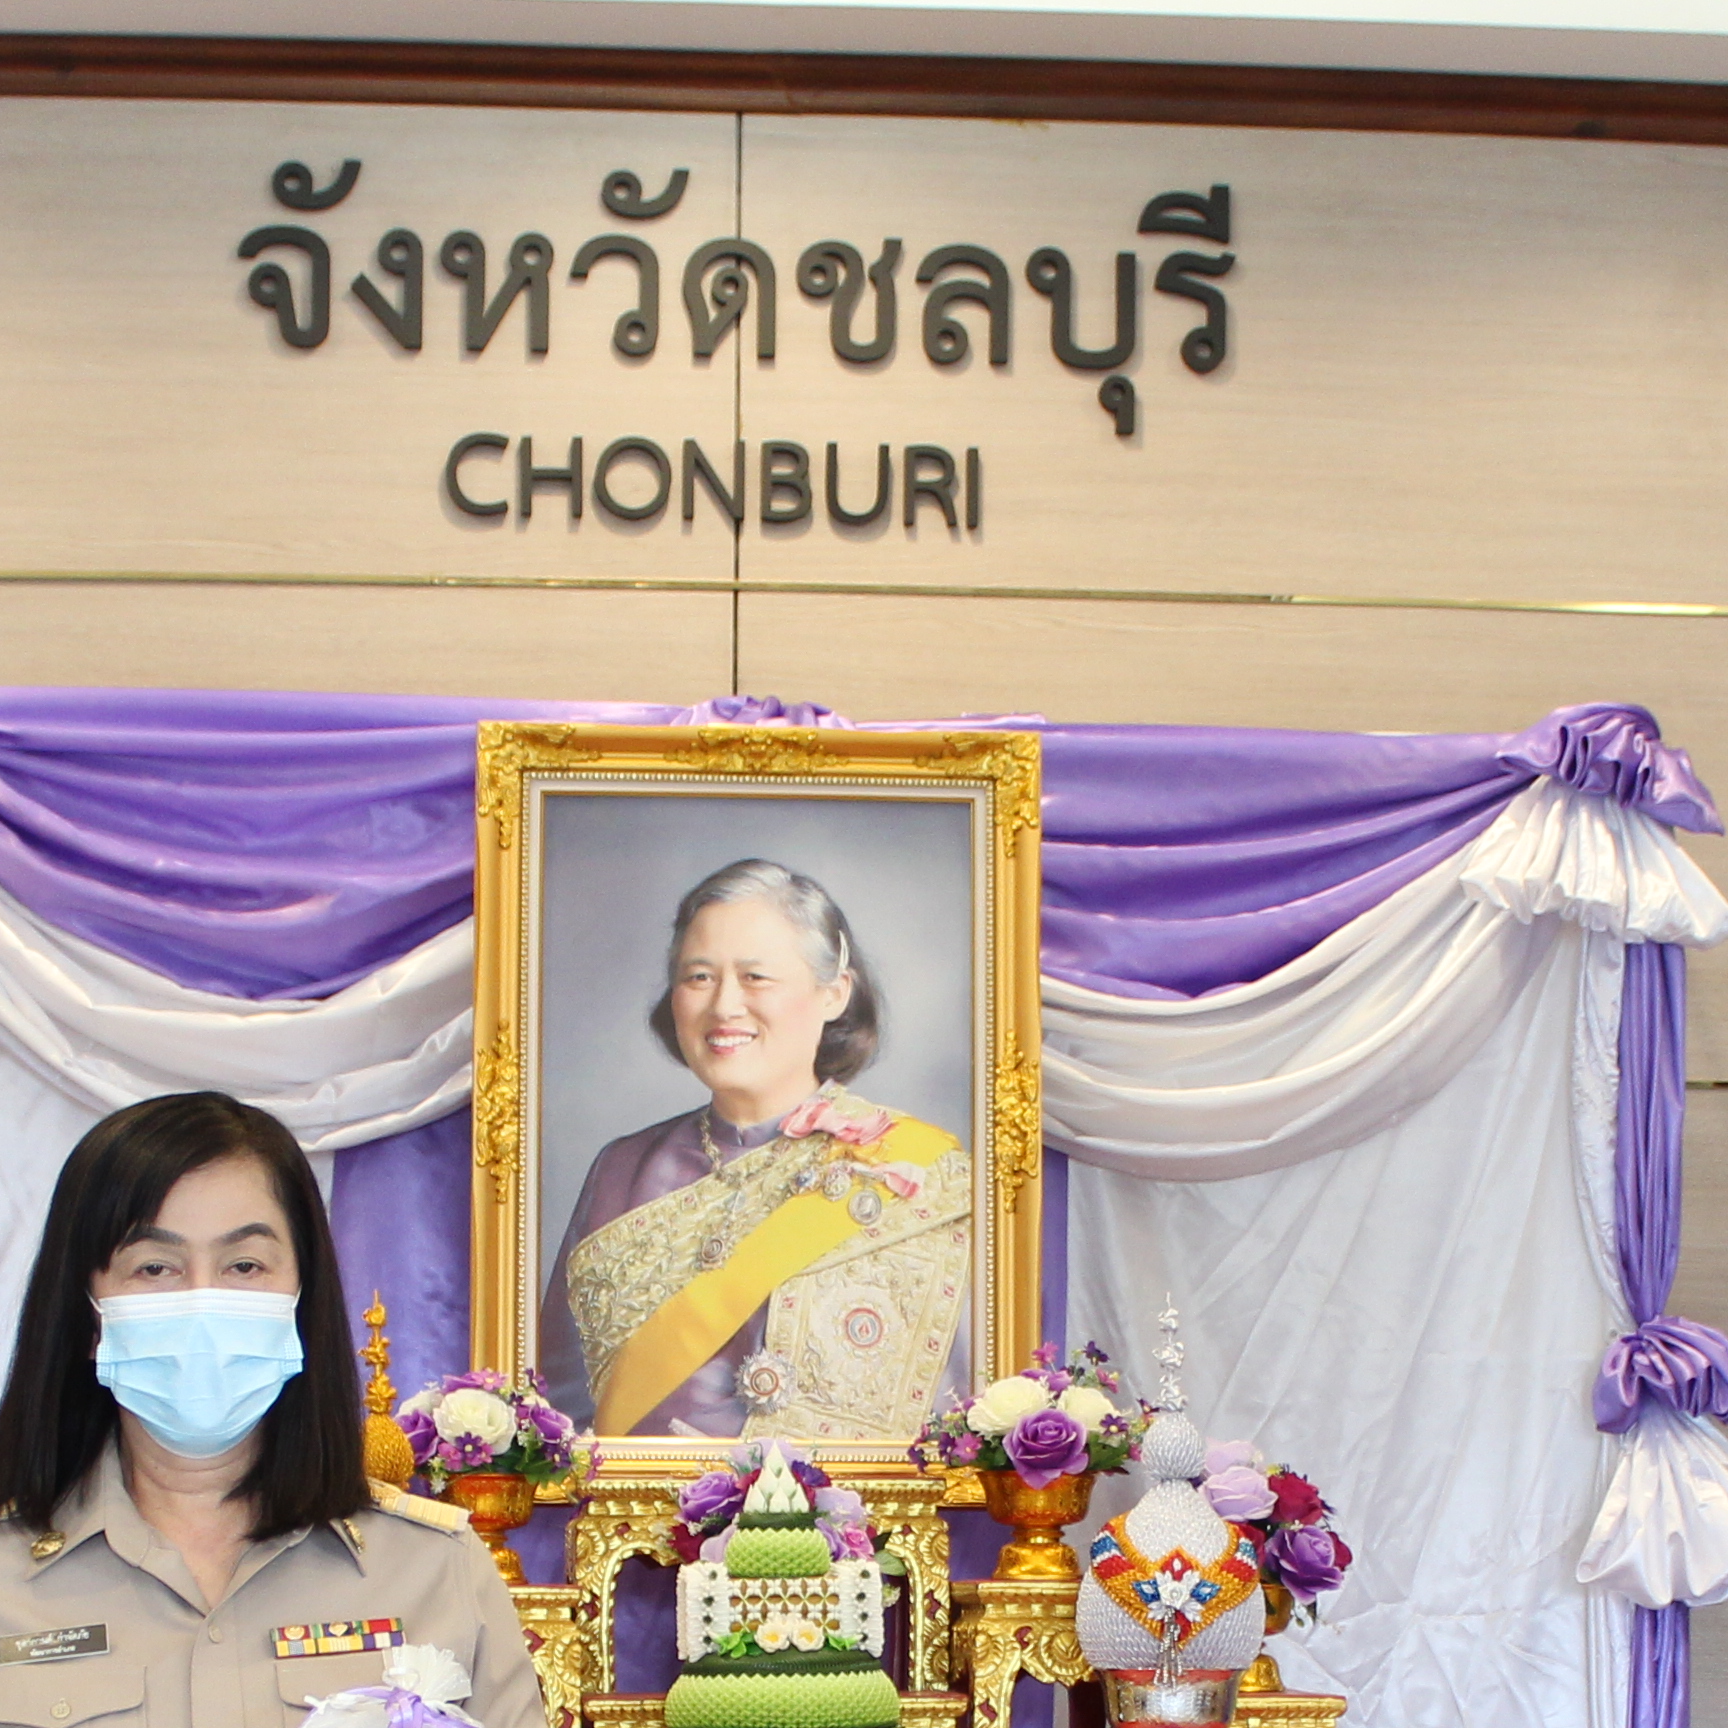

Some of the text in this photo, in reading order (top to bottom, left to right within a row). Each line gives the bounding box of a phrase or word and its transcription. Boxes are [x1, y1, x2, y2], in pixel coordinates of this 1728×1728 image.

[238, 159, 1236, 438] จังหวัดชลบุรี
[446, 433, 979, 531] CHONBURI
